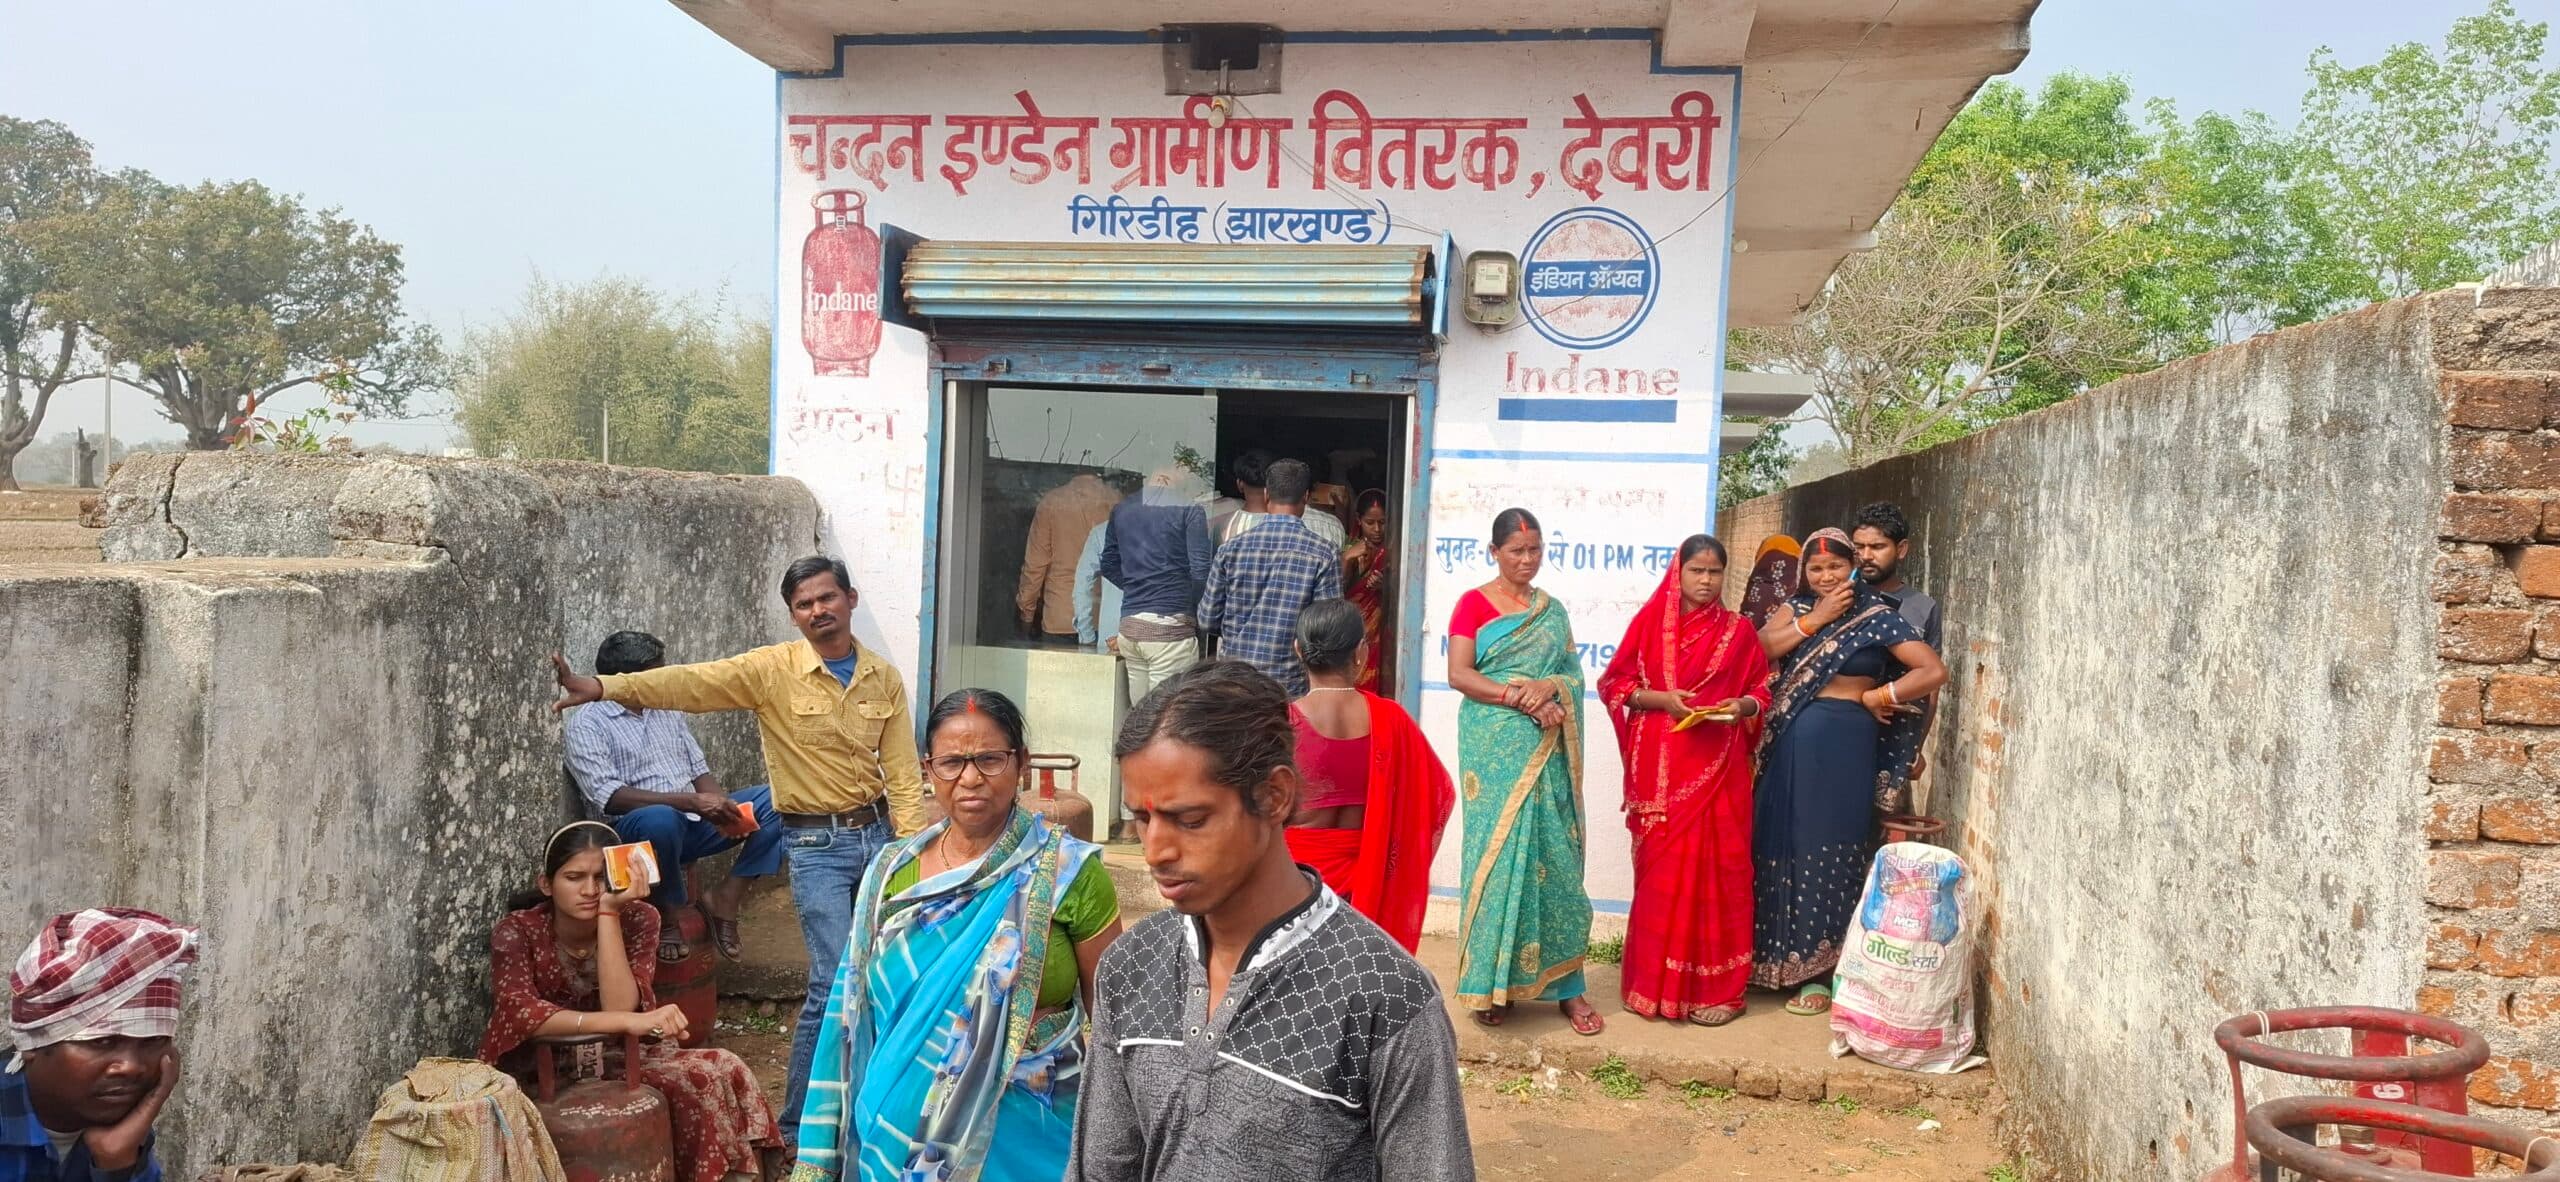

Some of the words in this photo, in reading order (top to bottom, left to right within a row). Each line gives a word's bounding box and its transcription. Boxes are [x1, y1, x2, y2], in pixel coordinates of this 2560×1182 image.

[788, 114, 932, 192] चन्दन
[940, 90, 1099, 196] इण्डेन
[1109, 95, 1293, 193] ग्रामीण
[1560, 90, 1721, 202] देवरी
[1067, 194, 1208, 244] गिरिडीह
[1530, 266, 1586, 293] इंडियन
[1588, 264, 1645, 290] ऑयल
[1503, 351, 1680, 396] Indane
[1573, 543, 1596, 570] 01
[1604, 544, 1634, 571] PM
[1866, 935, 1911, 966] गोल्ड
